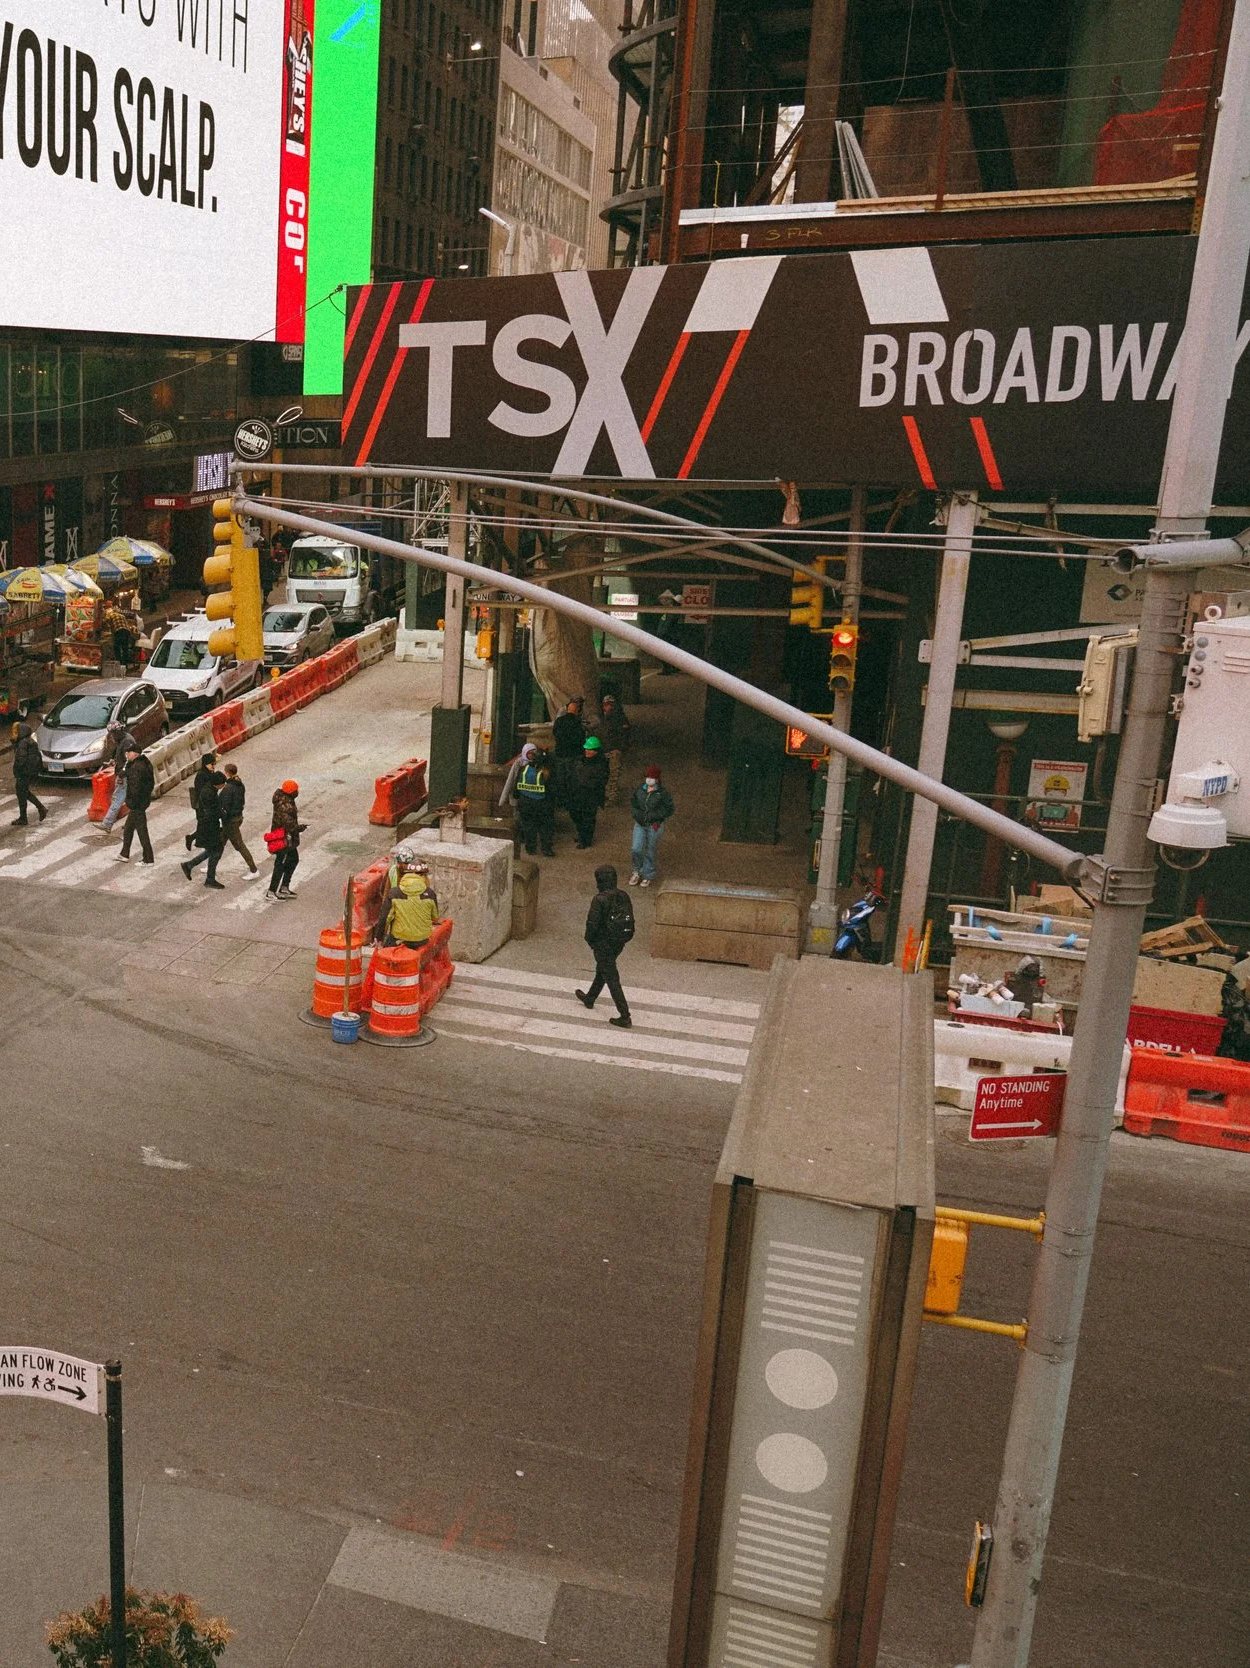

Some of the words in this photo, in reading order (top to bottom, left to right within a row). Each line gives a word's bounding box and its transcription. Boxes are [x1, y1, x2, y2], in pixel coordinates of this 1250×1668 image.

[112, 67, 218, 213] SCALP.
[399, 265, 668, 480] TSX
[275, 426, 329, 445] ITION
[7, 592, 40, 600] SABRETT
[518, 783, 544, 791] SECURITY
[1202, 775, 1228, 797] NYPD
[981, 1083, 997, 1095] NO
[1000, 1080, 1051, 1095] STANDING
[979, 1097, 1023, 1112] Anytime
[22, 1354, 55, 1372] FLOW
[58, 1360, 87, 1383] ZONE
